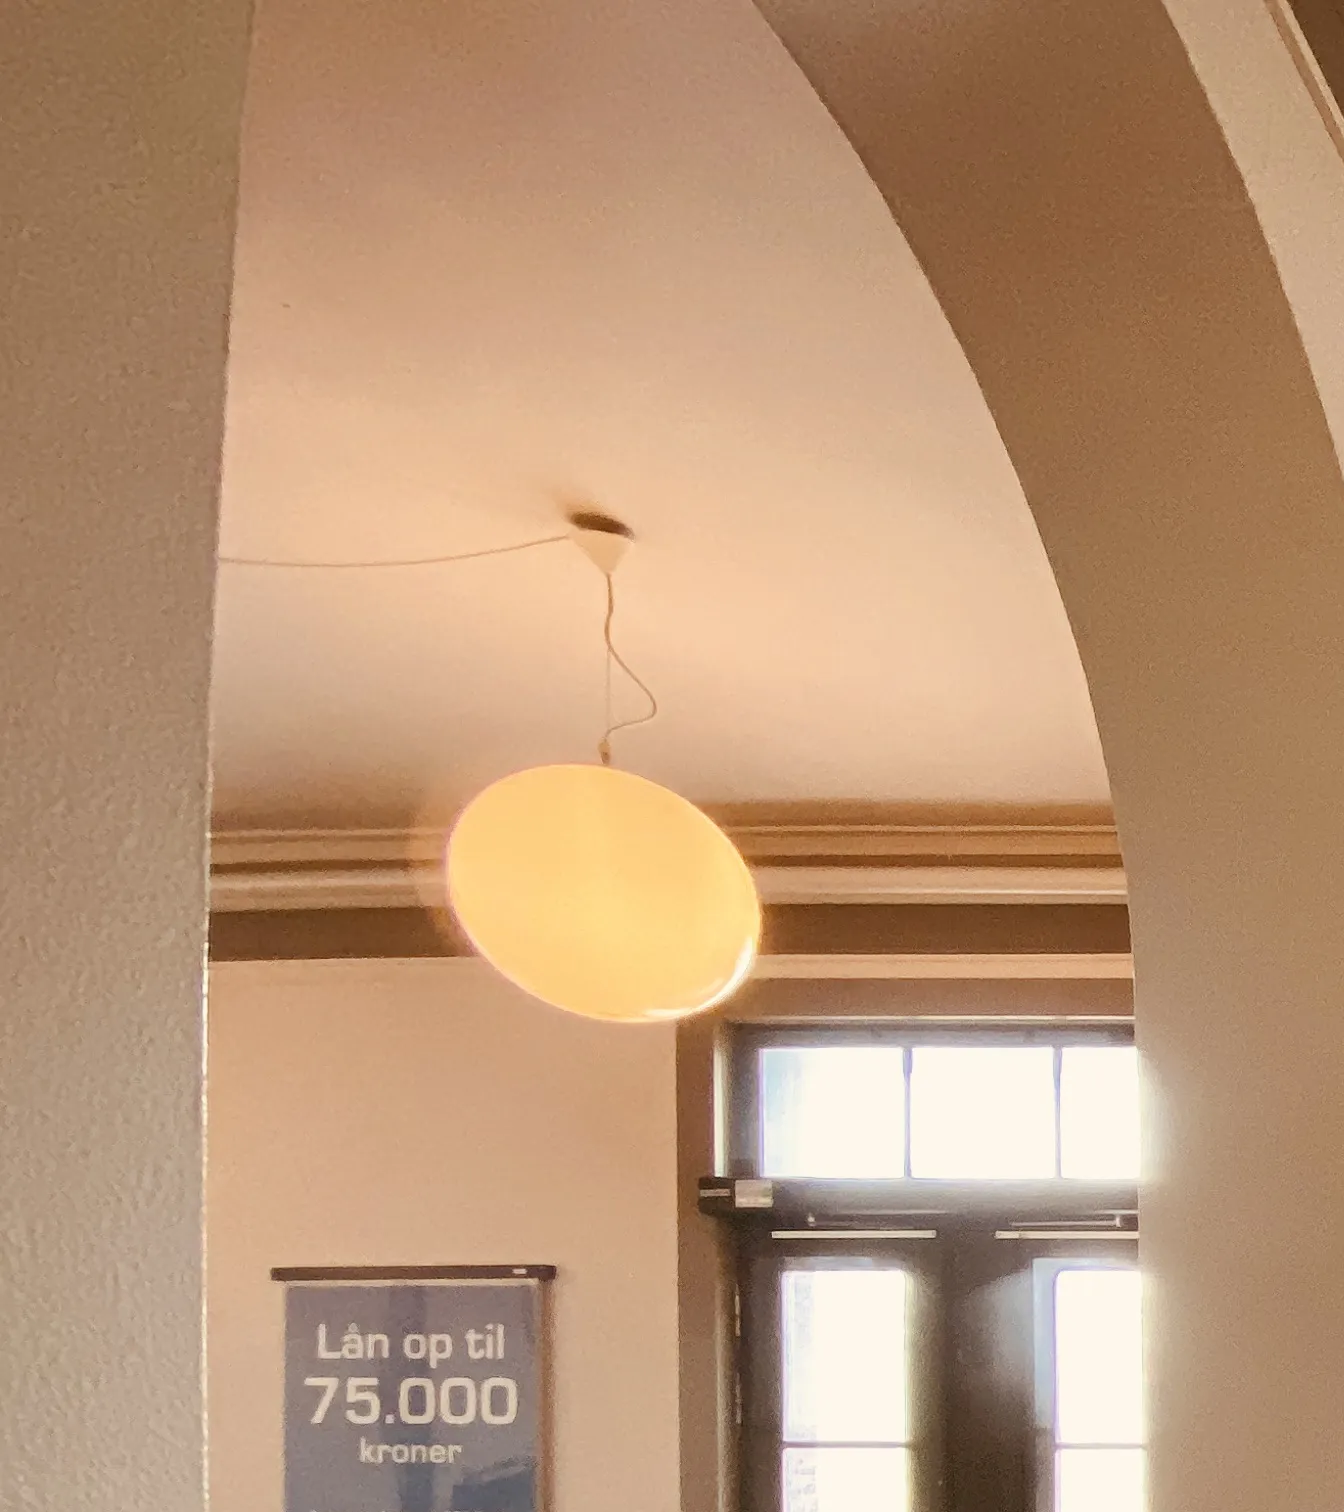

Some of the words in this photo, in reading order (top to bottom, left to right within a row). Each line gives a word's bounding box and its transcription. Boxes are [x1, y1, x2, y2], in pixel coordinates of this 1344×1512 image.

[317, 1322, 390, 1360] Lån
[403, 1331, 453, 1369] op
[465, 1323, 506, 1360] til
[304, 1376, 519, 1425] 75.000
[359, 1436, 464, 1465] kroner
